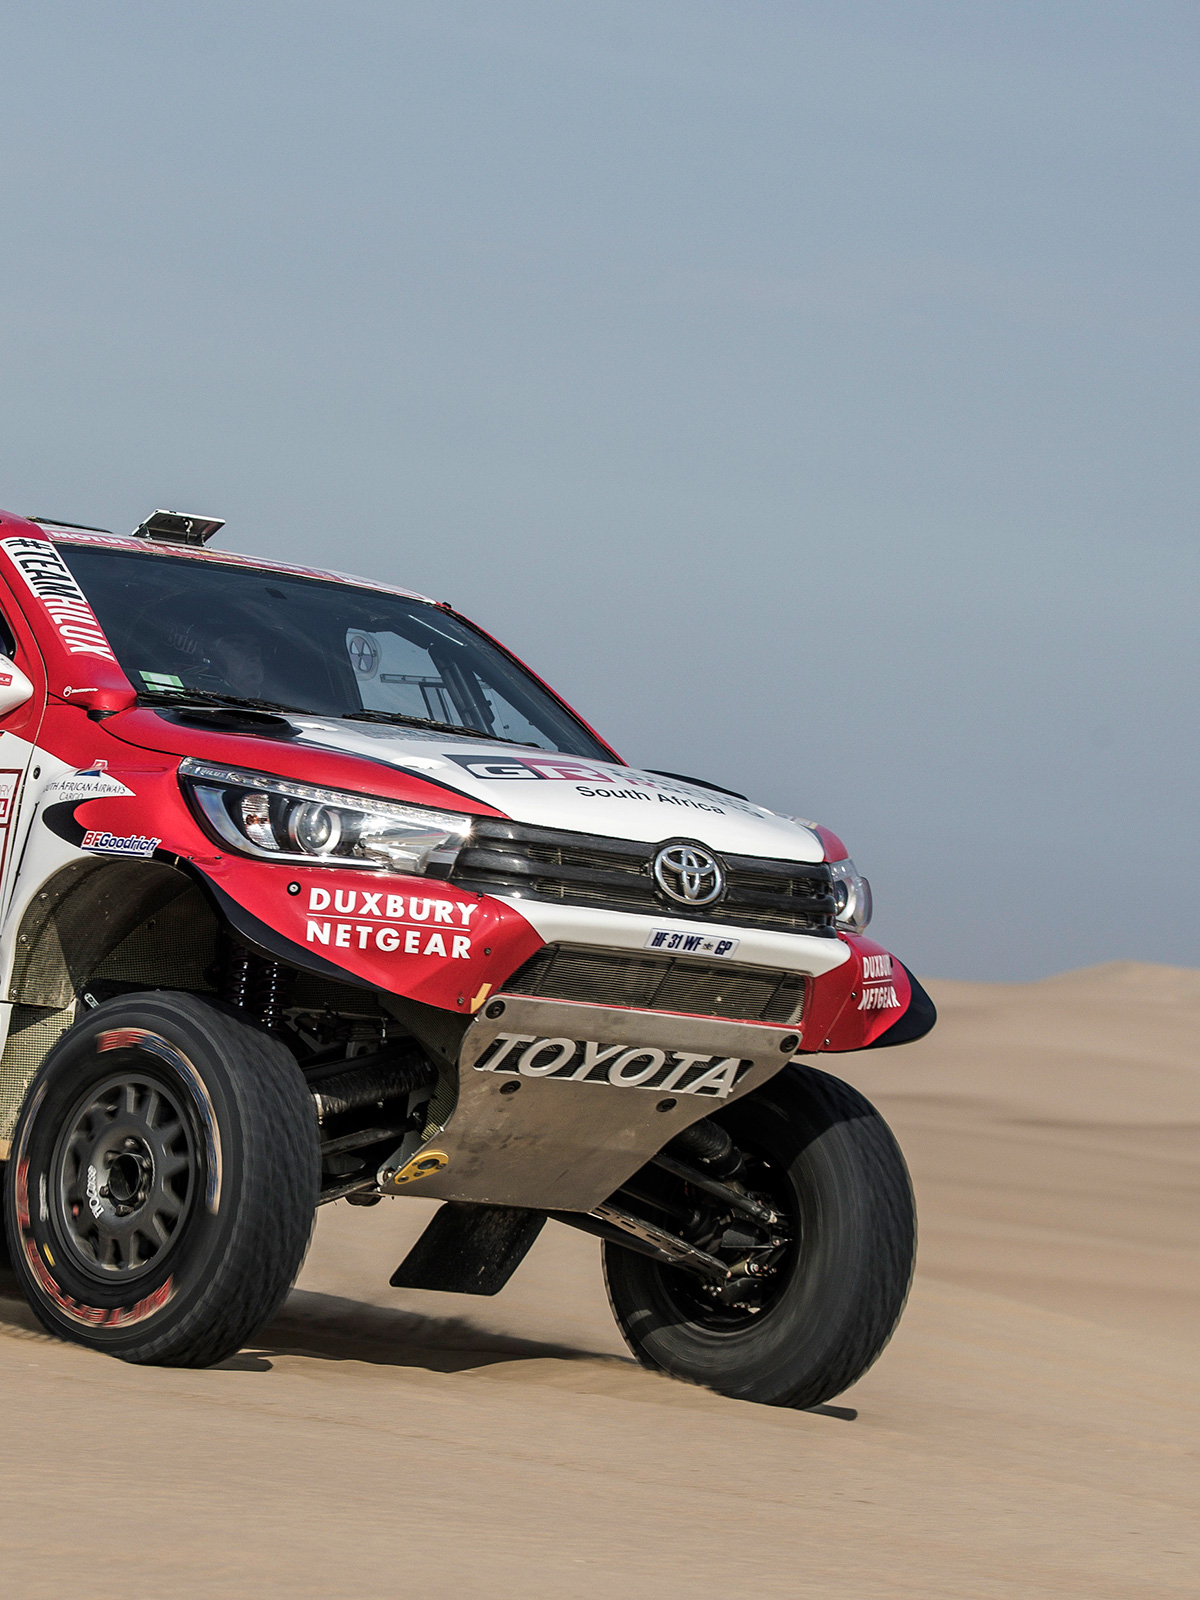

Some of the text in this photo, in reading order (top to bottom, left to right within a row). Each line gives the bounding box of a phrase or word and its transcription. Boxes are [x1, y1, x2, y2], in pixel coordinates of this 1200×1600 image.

[52, 531, 132, 546] MOTUL
[59, 781, 94, 792] AFRICAN
[91, 782, 126, 794] AIRWAYS
[575, 785, 726, 815] South Africa
[309, 887, 478, 925] DUXBURY
[306, 920, 472, 959] NETGEAR
[667, 934, 683, 949] 31
[683, 935, 704, 952] WF
[714, 940, 733, 955] GP
[857, 986, 901, 1010] NETGEAR
[486, 1032, 743, 1098] TOYOTA
